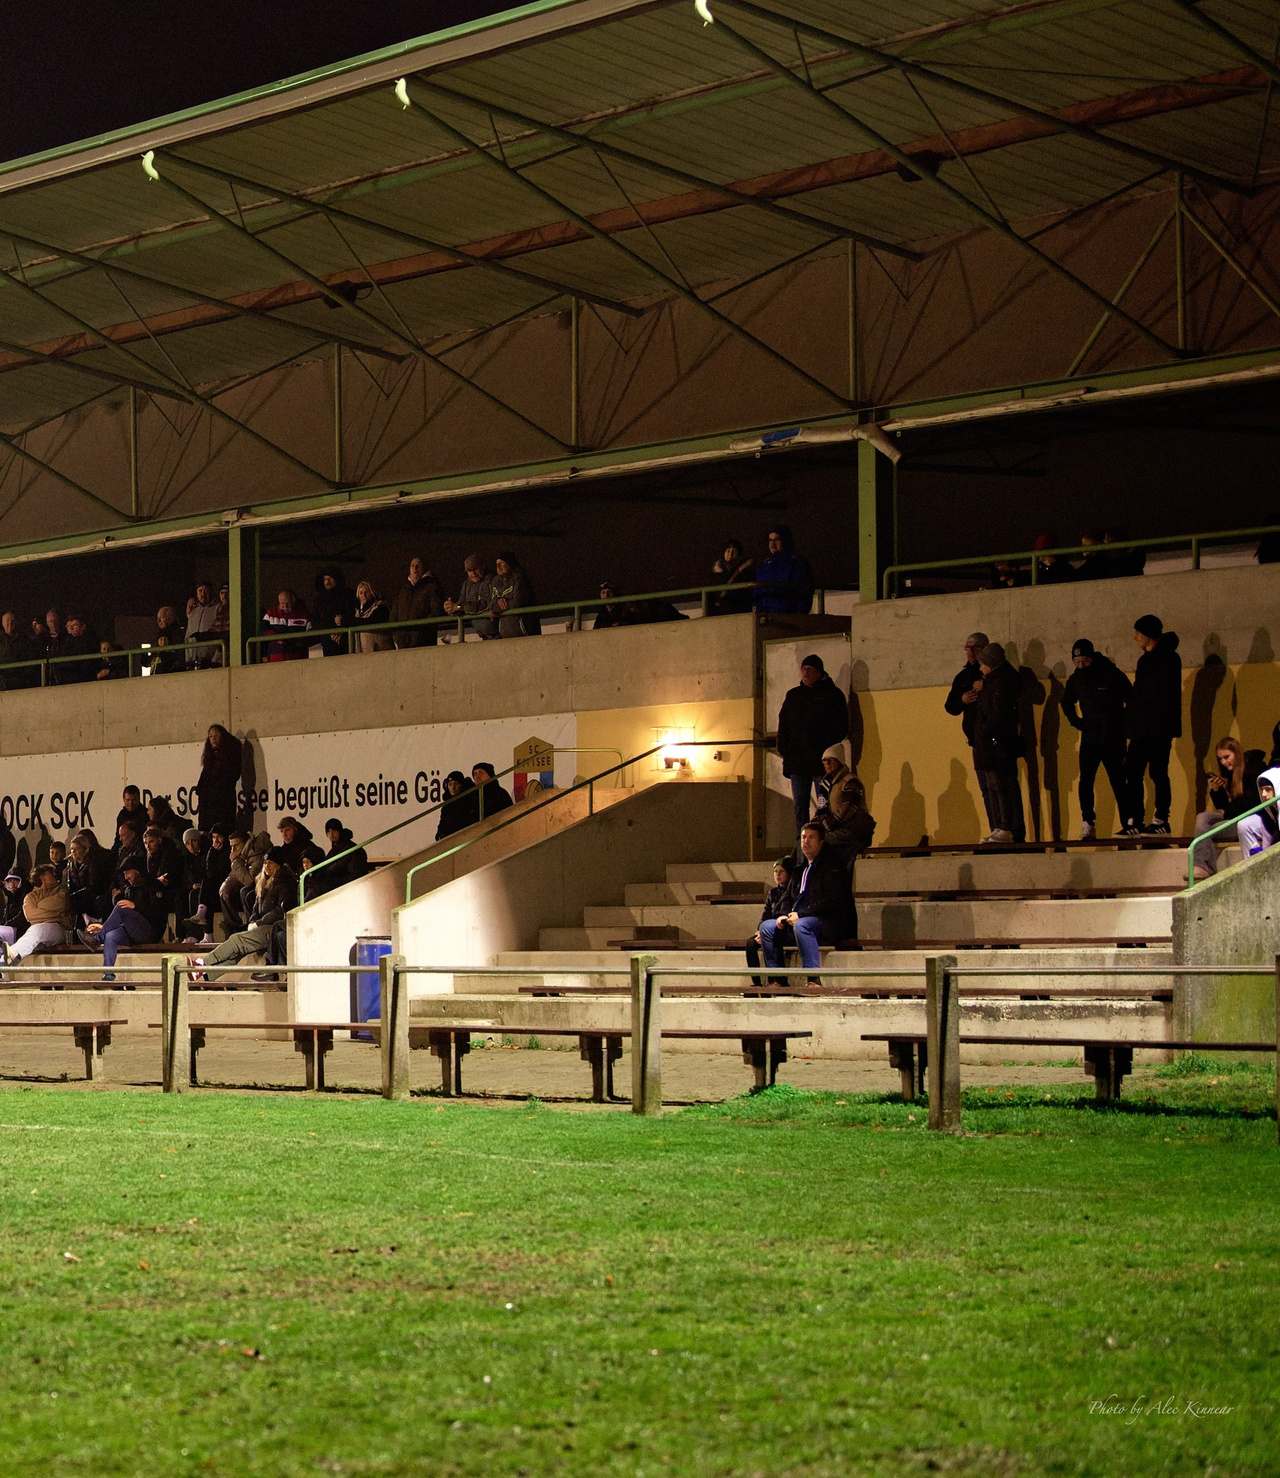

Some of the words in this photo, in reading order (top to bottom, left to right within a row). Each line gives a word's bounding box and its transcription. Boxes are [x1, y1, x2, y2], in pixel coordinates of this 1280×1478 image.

[528, 744, 540, 755] SC
[50, 790, 95, 830] SCK
[274, 774, 350, 818] begrüßt
[355, 773, 408, 807] seine
